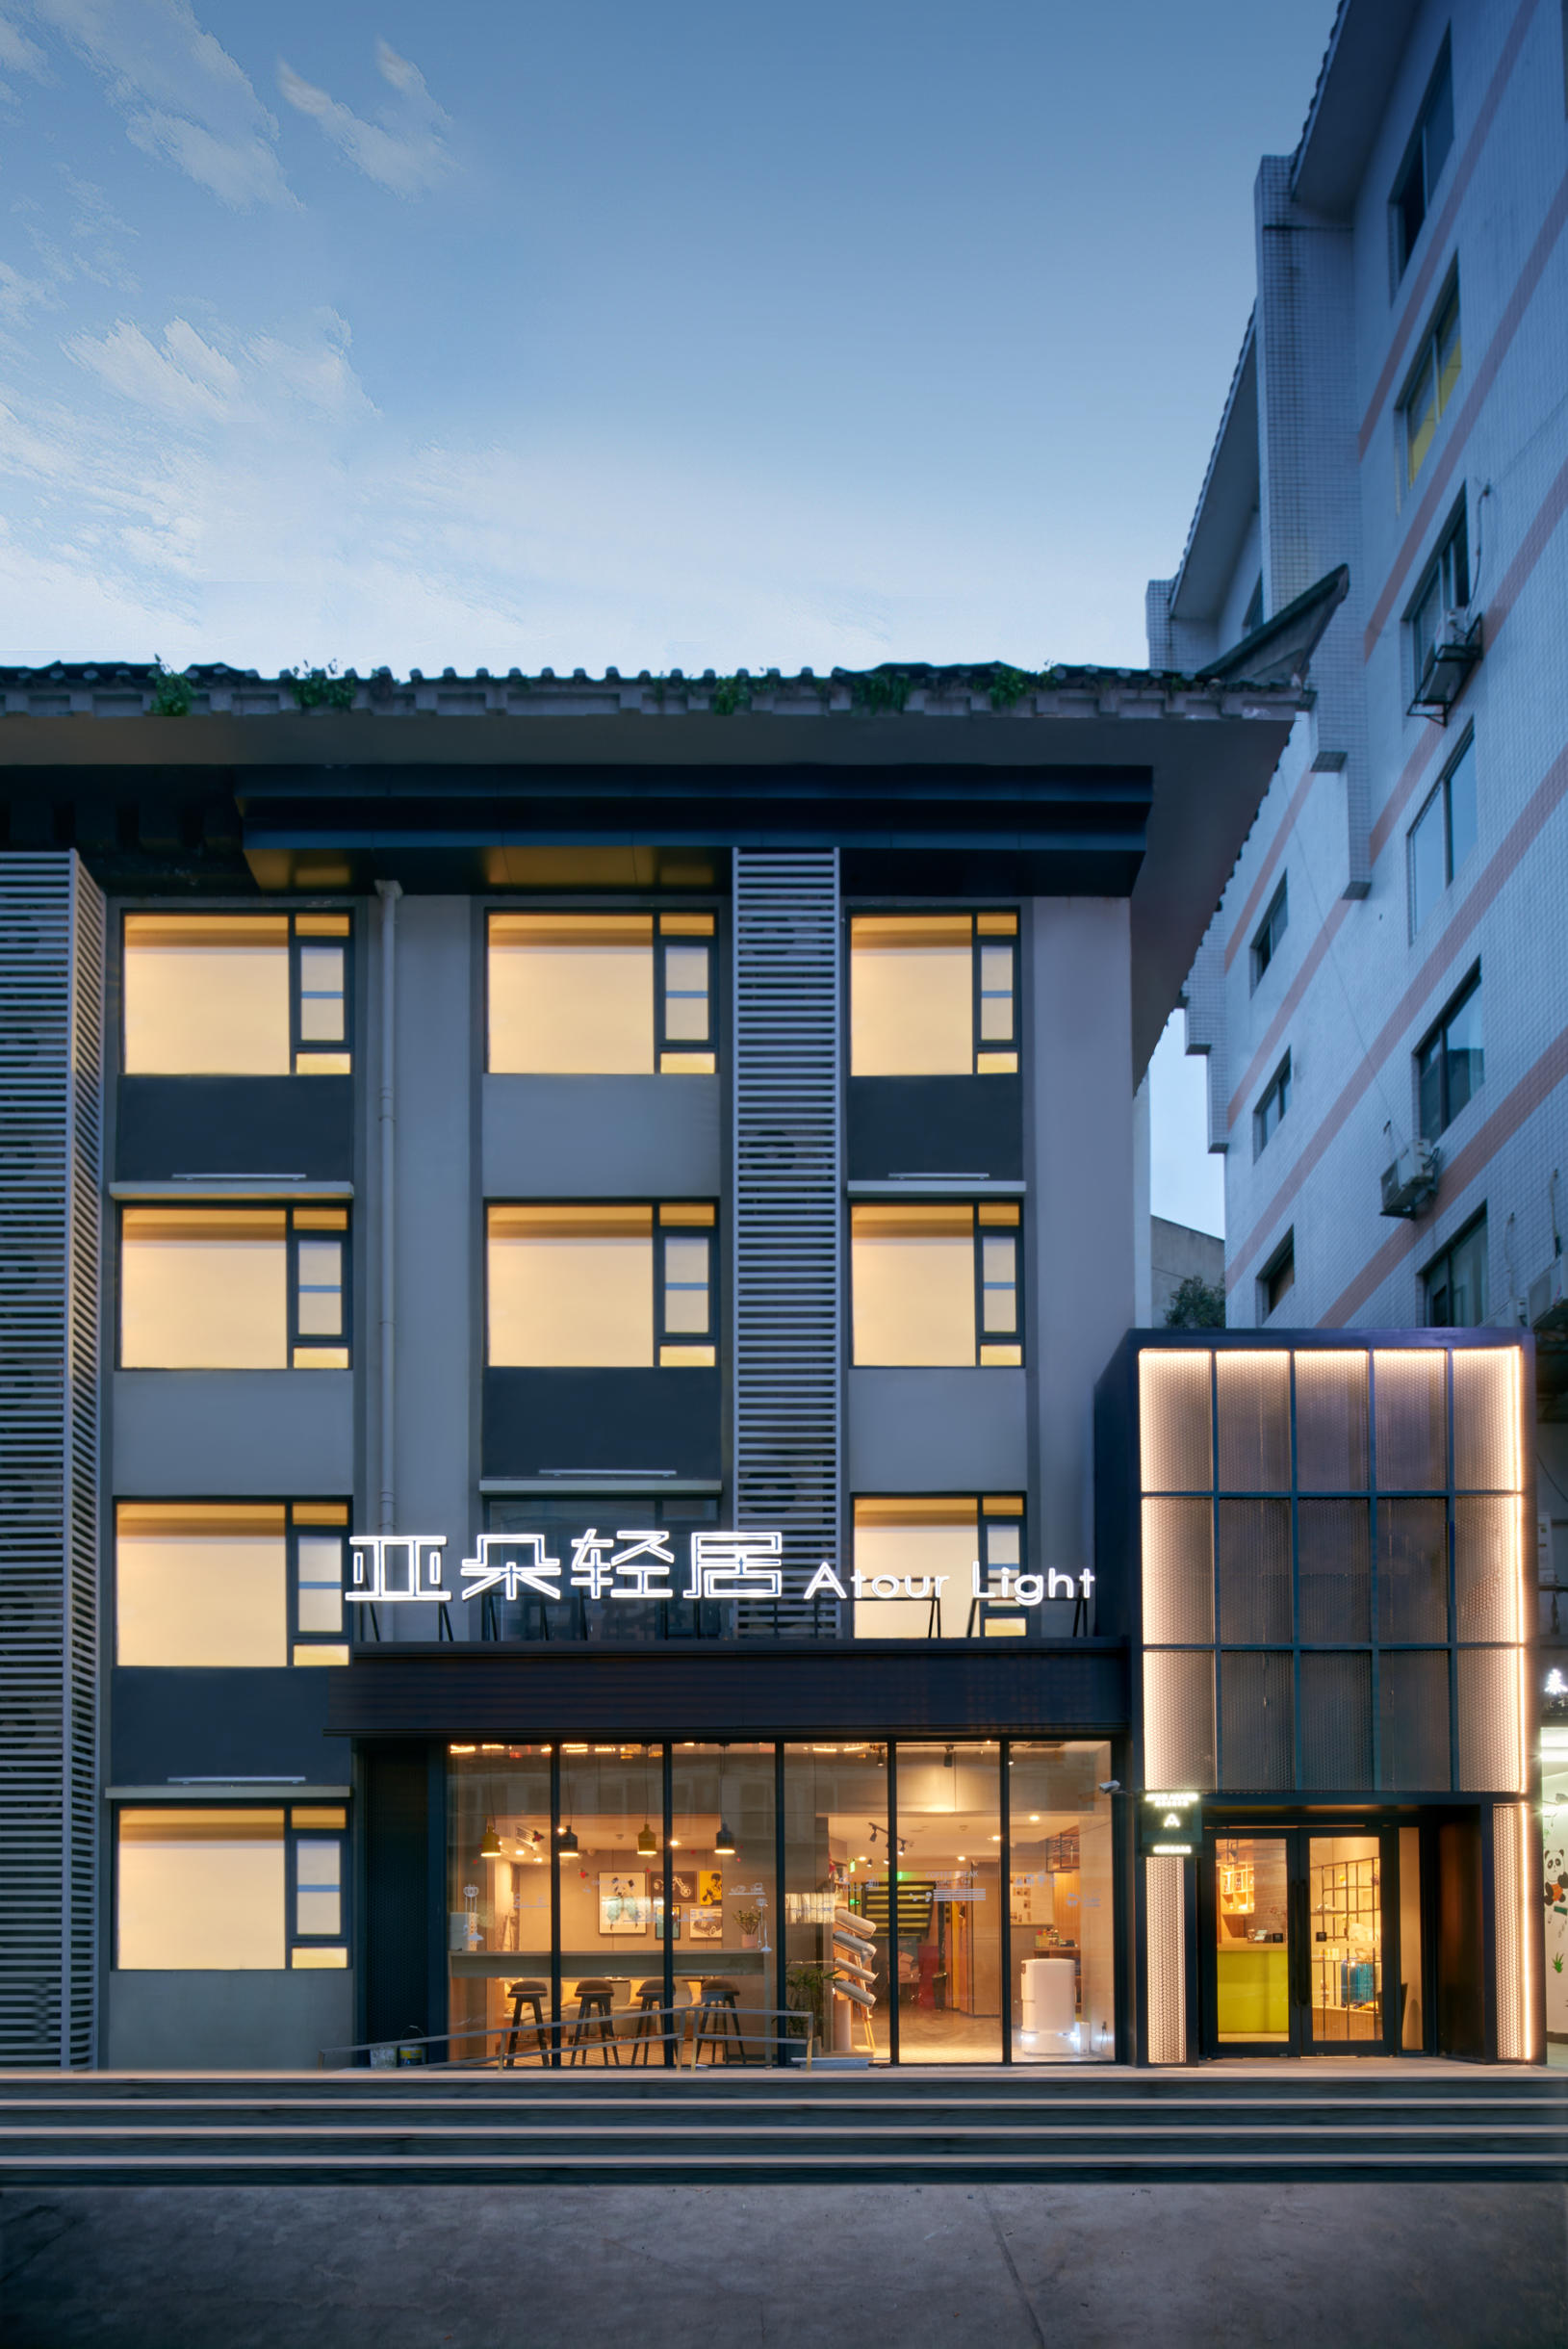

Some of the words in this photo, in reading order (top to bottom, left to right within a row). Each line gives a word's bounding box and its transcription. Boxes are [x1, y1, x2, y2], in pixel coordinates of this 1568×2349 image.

[345, 1529, 783, 1601] 亚朵轻居
[804, 1562, 950, 1599] Atour
[972, 1561, 1095, 1606] Light
